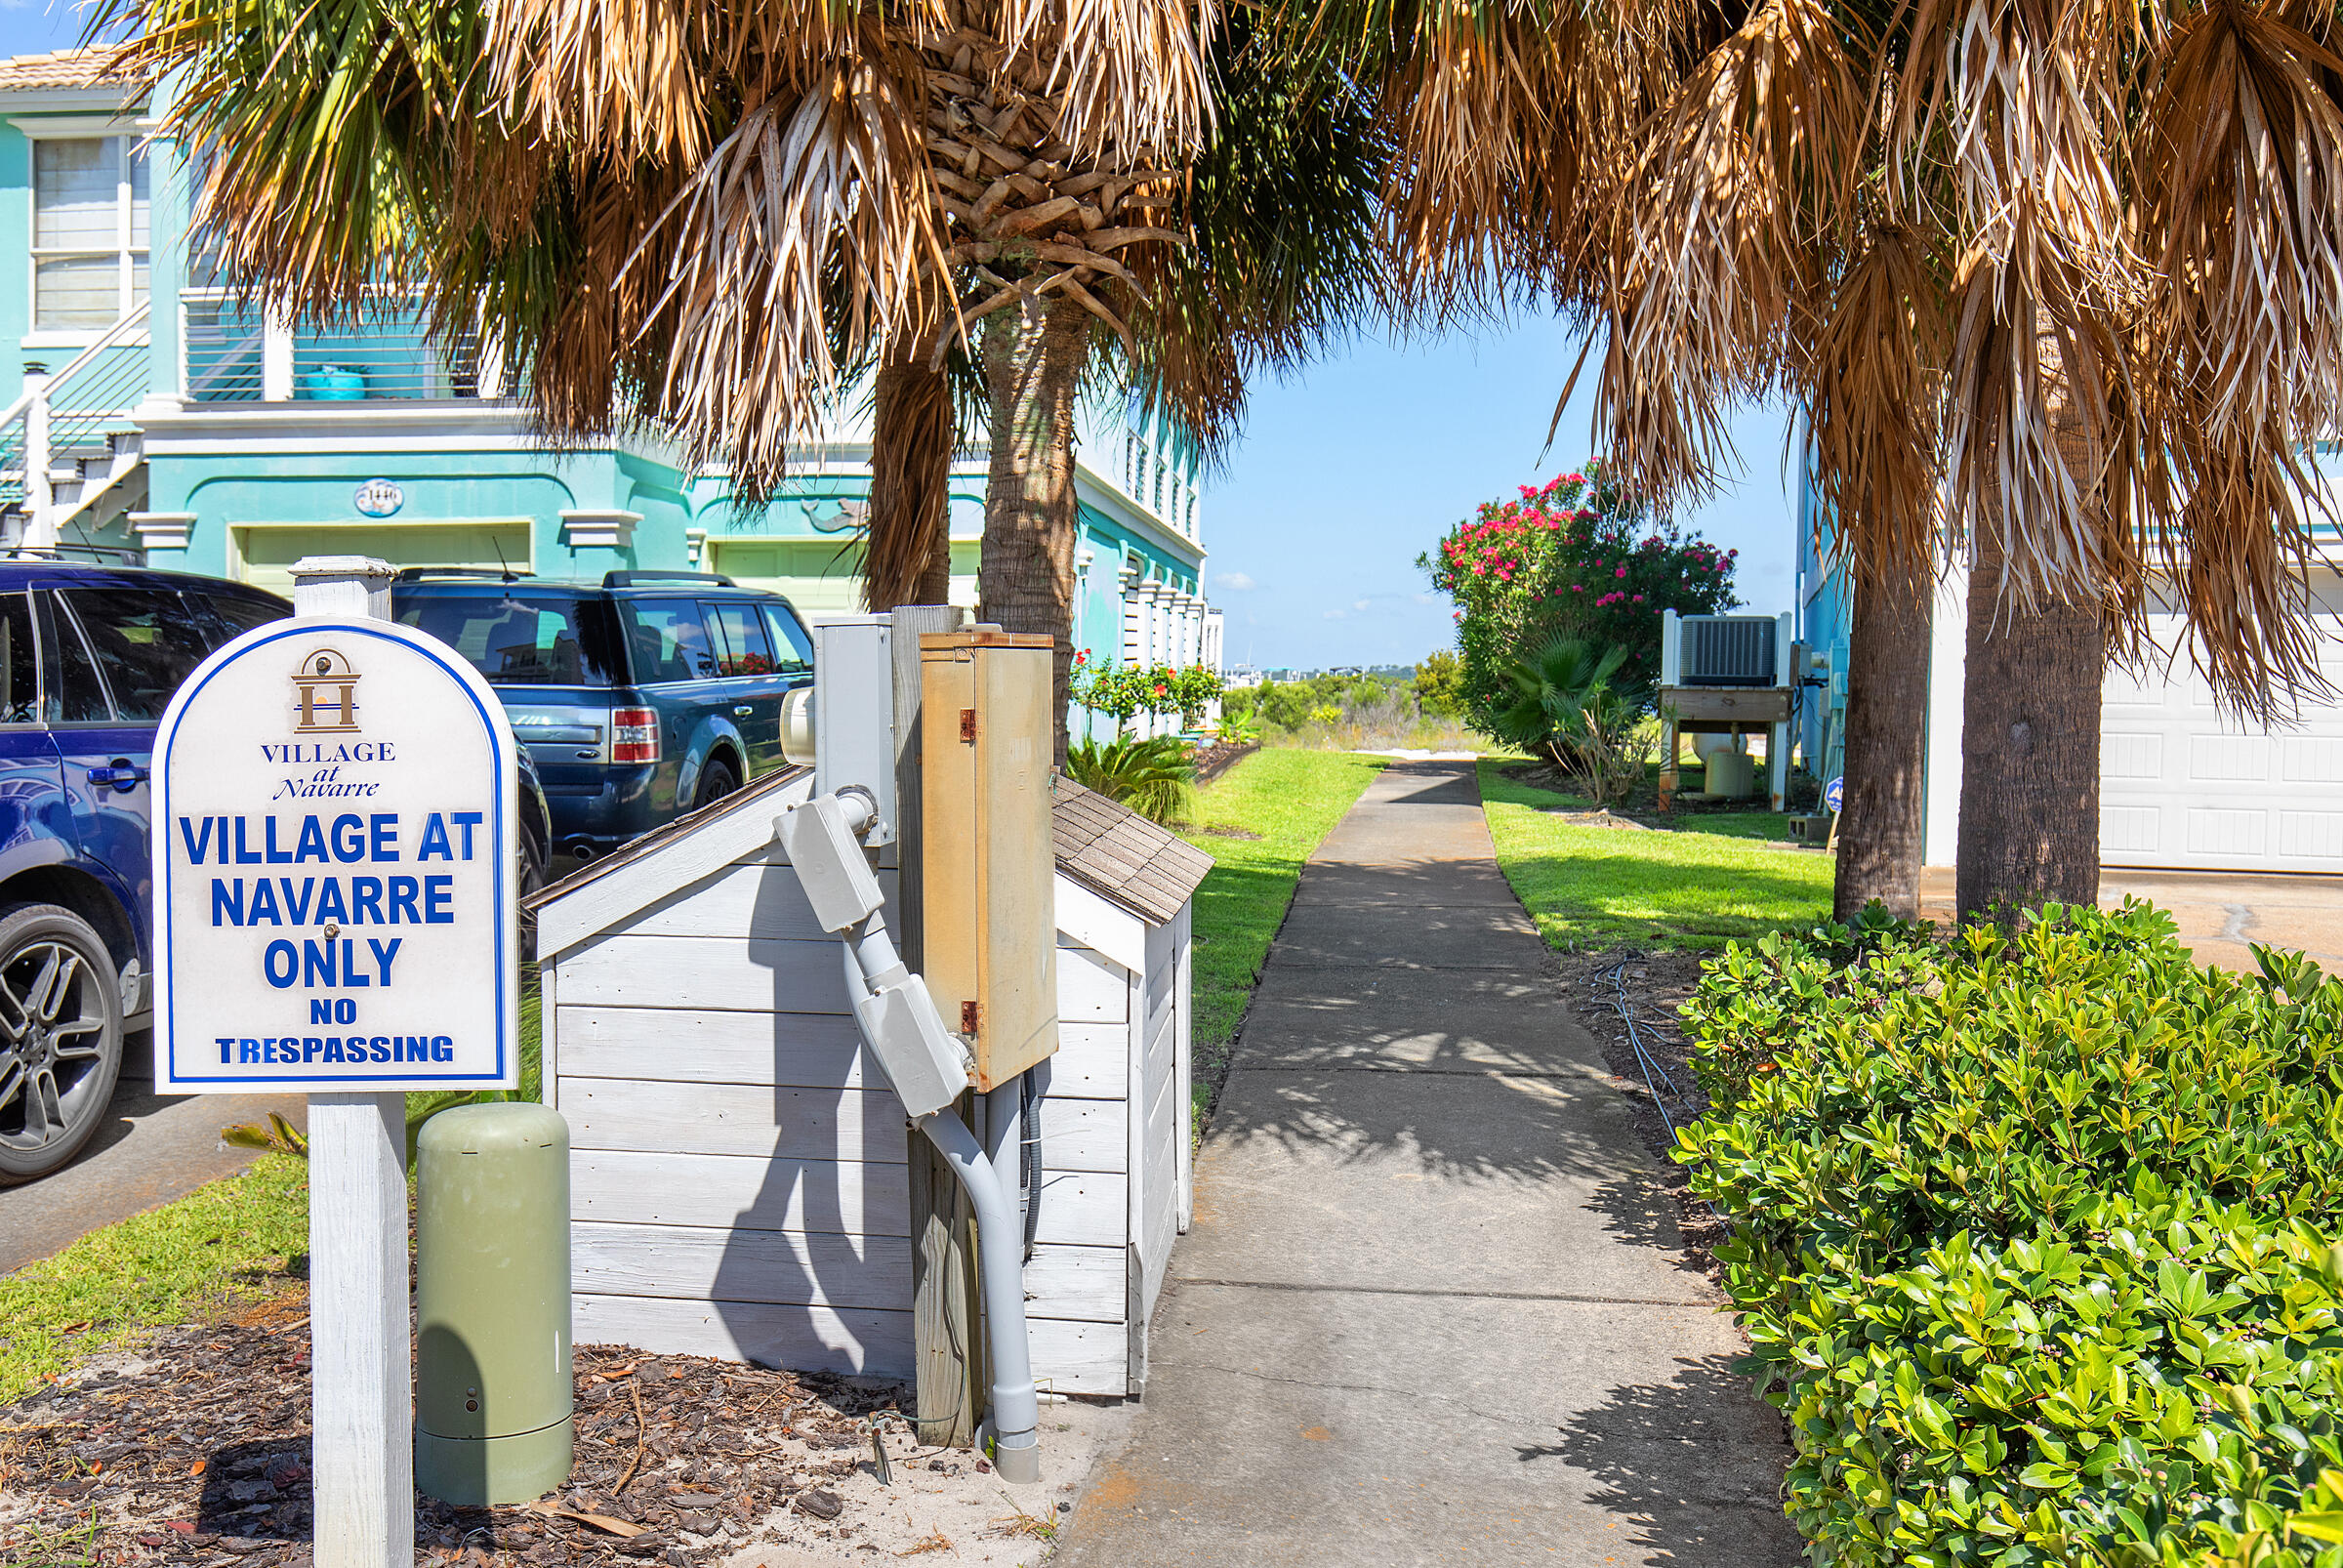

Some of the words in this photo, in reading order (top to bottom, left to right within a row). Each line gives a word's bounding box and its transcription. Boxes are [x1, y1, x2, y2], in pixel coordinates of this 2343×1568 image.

[261, 742, 396, 763] VILLAGE
[312, 765, 341, 783] at
[272, 778, 381, 801] Navarre
[179, 813, 400, 865] VILLAGE
[417, 812, 483, 862] AT
[211, 875, 455, 927] NAVARRE
[264, 937, 402, 989] ONLY
[310, 998, 357, 1025] NO
[215, 1036, 454, 1064] TRESPASSING
